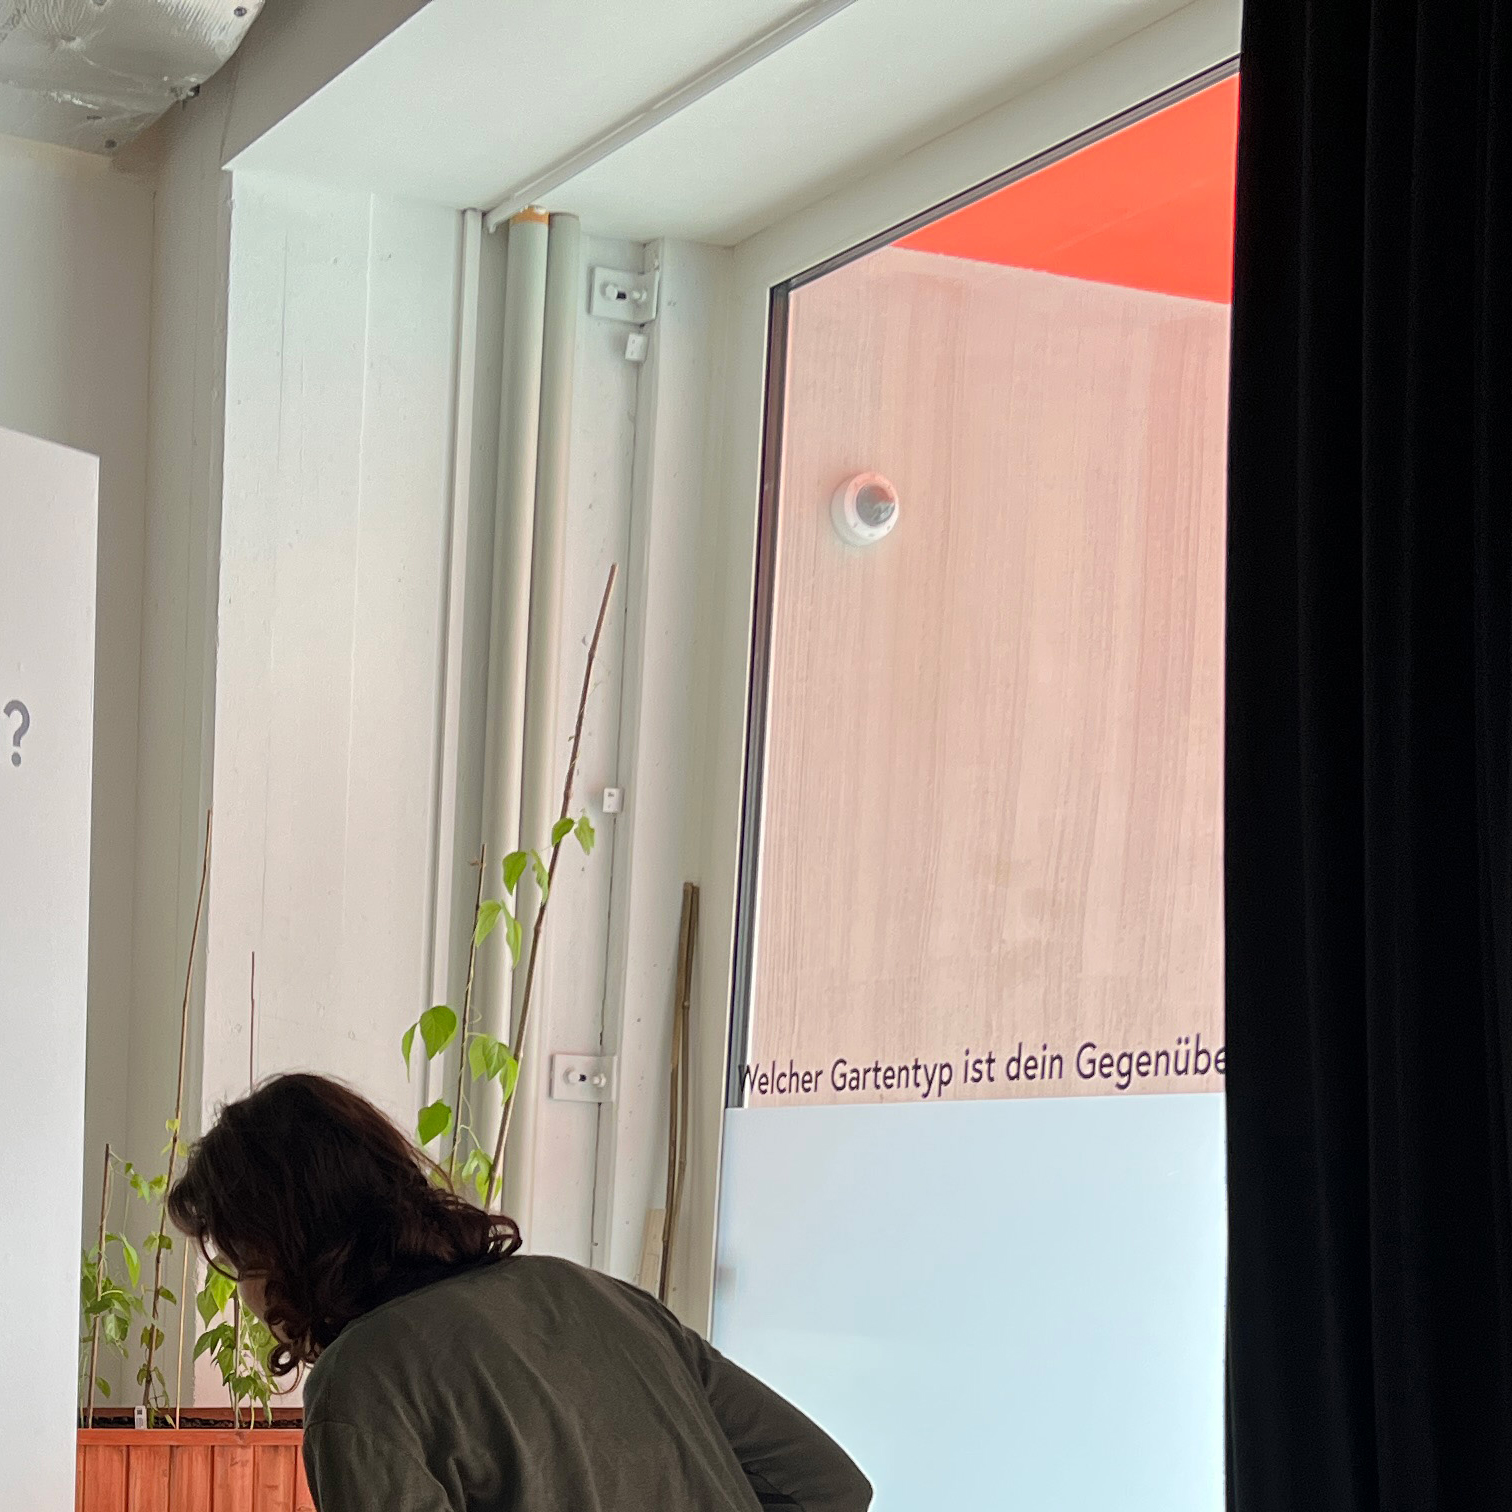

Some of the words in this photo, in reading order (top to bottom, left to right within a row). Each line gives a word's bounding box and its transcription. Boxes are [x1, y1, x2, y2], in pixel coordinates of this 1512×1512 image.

[739, 1059, 823, 1095] Welcher
[831, 1057, 953, 1099] Gartentyp
[963, 1048, 996, 1084] ist
[1006, 1041, 1064, 1081] dein
